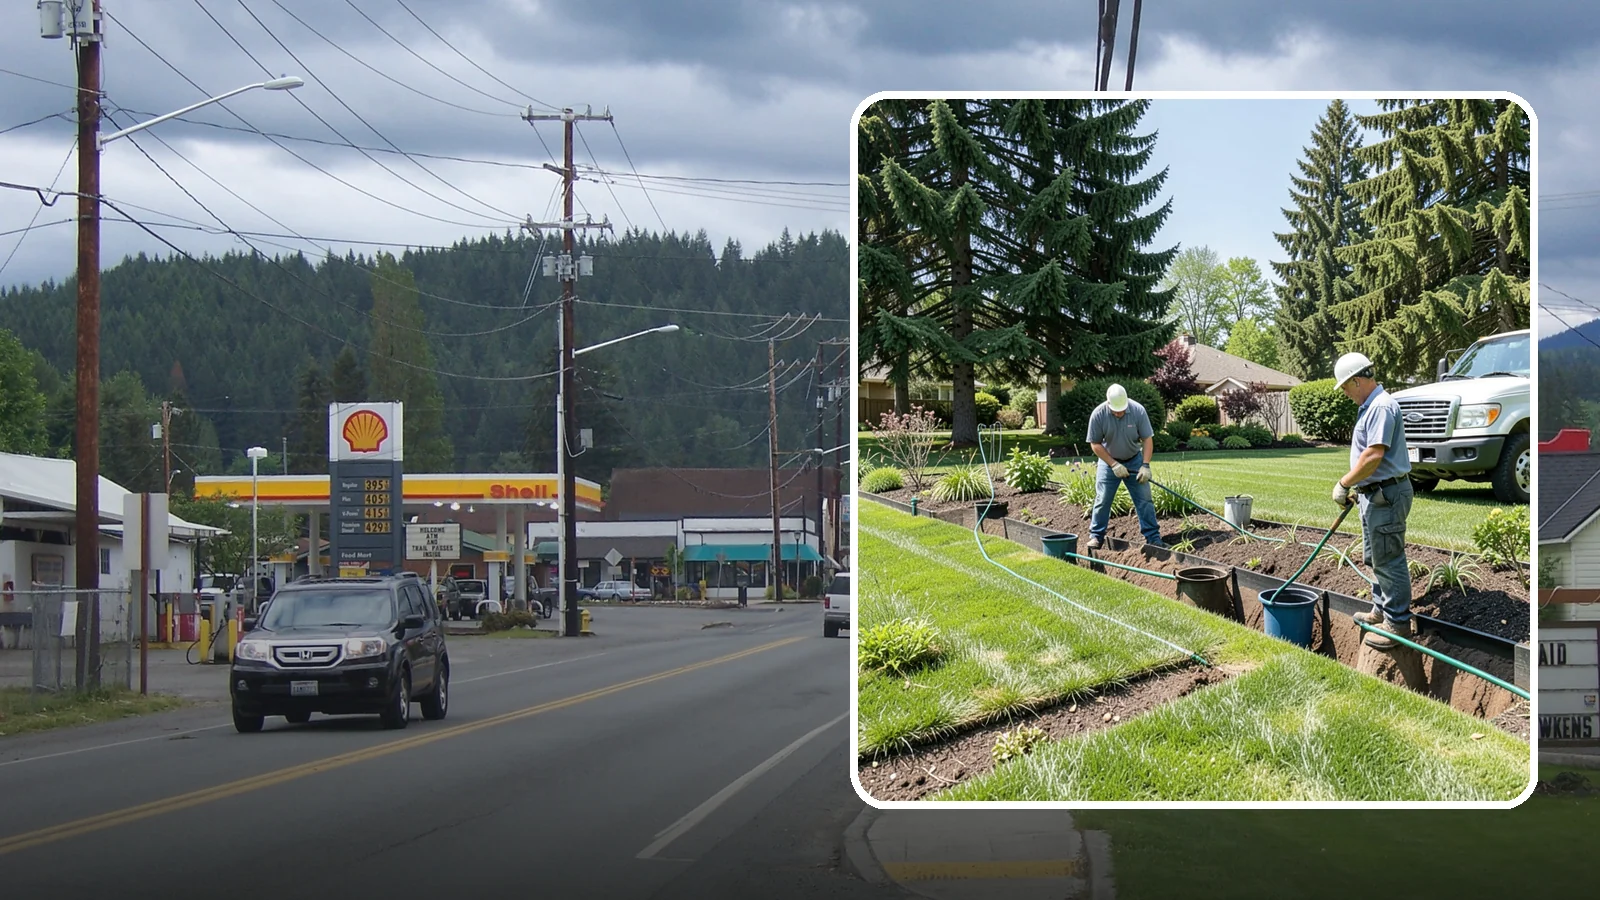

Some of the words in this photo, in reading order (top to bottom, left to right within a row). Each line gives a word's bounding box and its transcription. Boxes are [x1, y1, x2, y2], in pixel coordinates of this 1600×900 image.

[342, 480, 358, 489] Regular
[365, 480, 384, 490] 395
[490, 484, 547, 499] Shell
[365, 494, 384, 504] 405
[365, 508, 384, 518] 415
[365, 522, 384, 532] 429
[1538, 642, 1567, 666] AID
